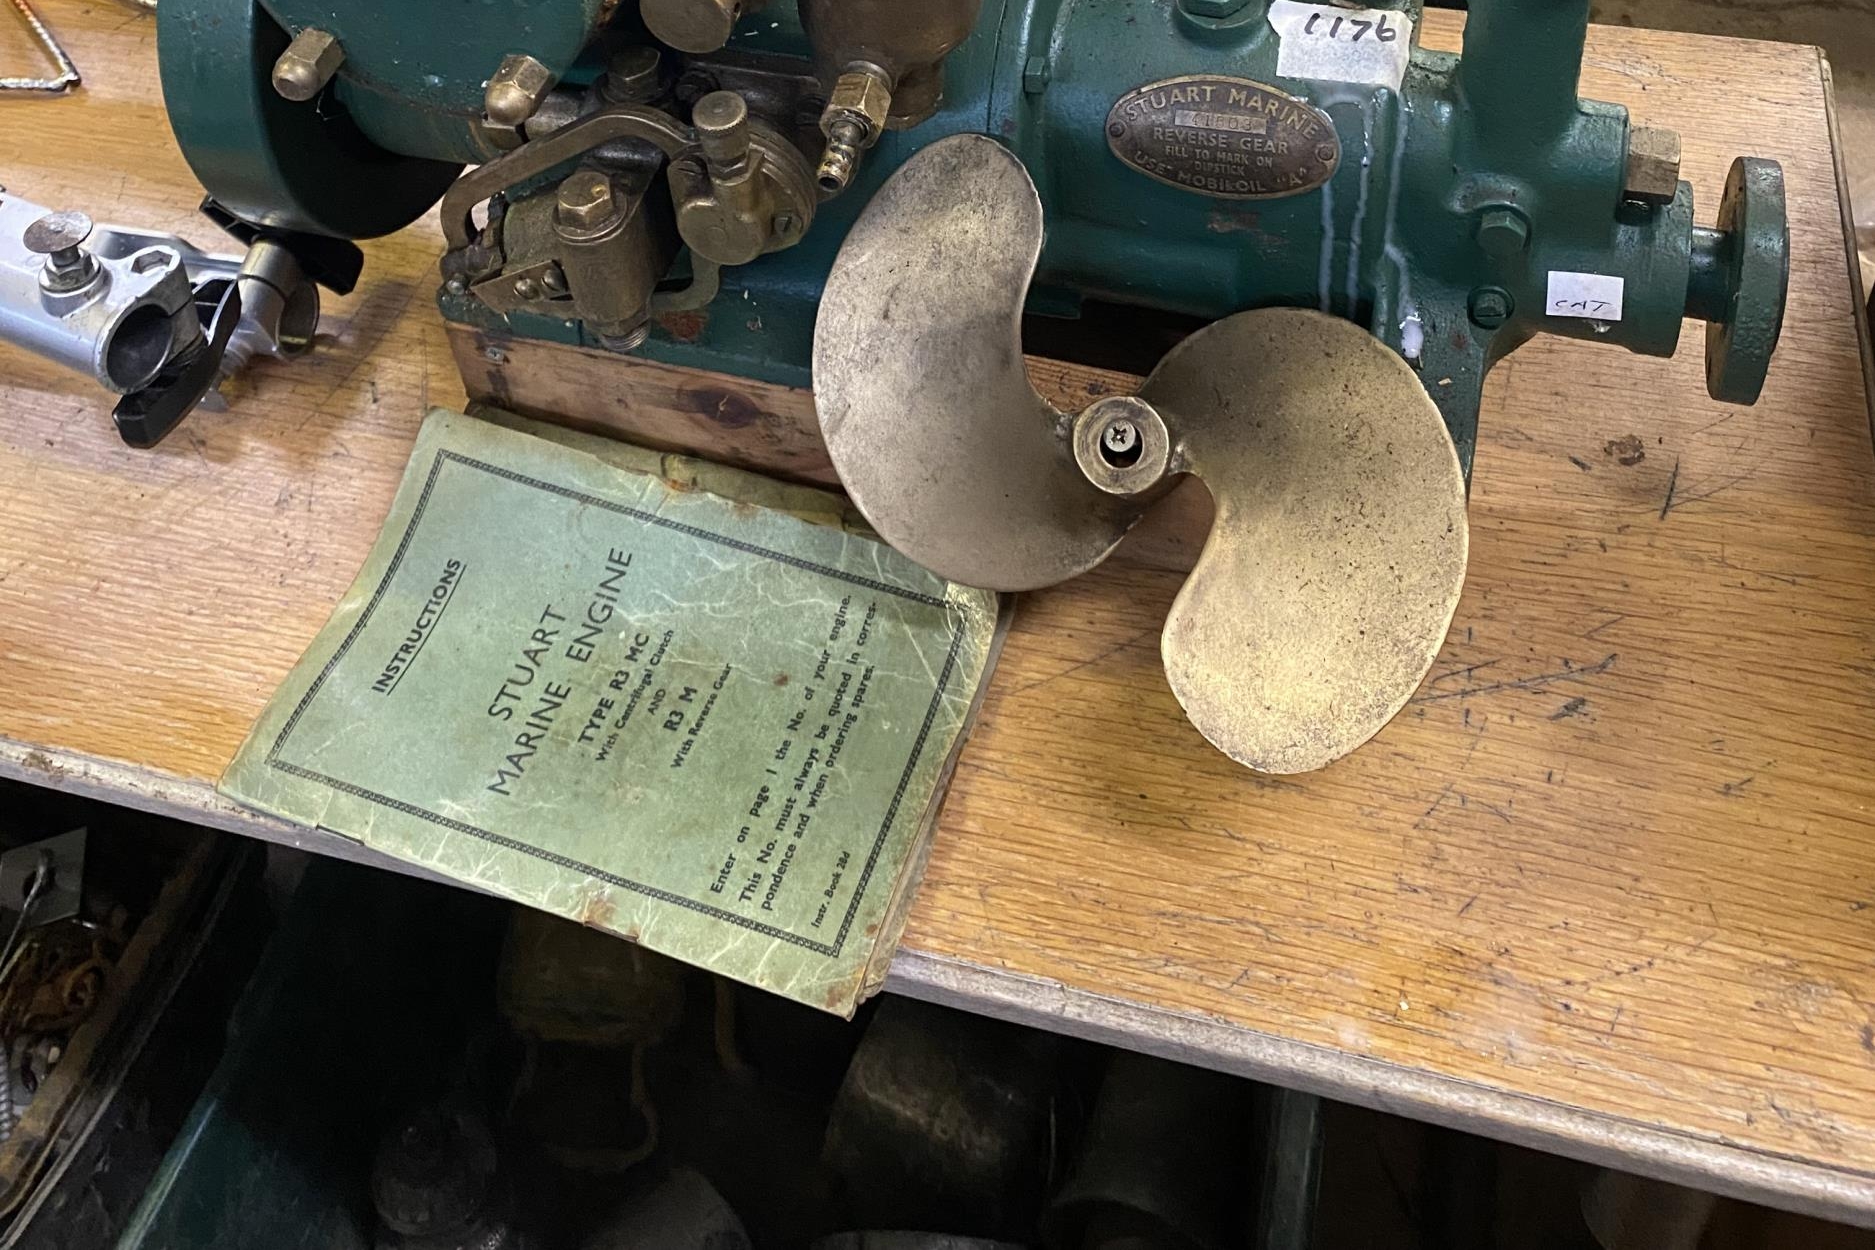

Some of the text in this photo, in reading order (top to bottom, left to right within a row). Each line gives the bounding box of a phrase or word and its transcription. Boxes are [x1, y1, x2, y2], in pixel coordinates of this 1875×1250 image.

[1304, 12, 1397, 43] 1176
[1125, 85, 1320, 140] STUART MARINE
[1153, 127, 1289, 155] REVERSE GEAR
[1165, 145, 1273, 168] FILL TO MARK ON
[1194, 161, 1245, 176] DIPSTICK
[371, 558, 461, 693] INSTRUCTIONS
[486, 548, 633, 796] MARINE ENGINE
[488, 604, 567, 721] STUART
[577, 632, 650, 743] TYPE R3 MC
[595, 629, 674, 762] With Centrifugal Clutch
[647, 688, 667, 715] AND
[662, 686, 698, 732] R3 M
[670, 663, 733, 769] With Reverse Gear
[710, 852, 737, 894] Enter
[737, 825, 750, 844] on
[750, 784, 770, 818] page
[775, 739, 792, 760] the
[787, 708, 807, 732] No.
[804, 686, 815, 701] of
[813, 649, 831, 681] your
[829, 594, 852, 641] engine.
[738, 602, 877, 902] This No. must always be quoted in corres-
[761, 664, 875, 911] pondence and when ordering spares.
[811, 851, 851, 929] Instr. Book 28d
